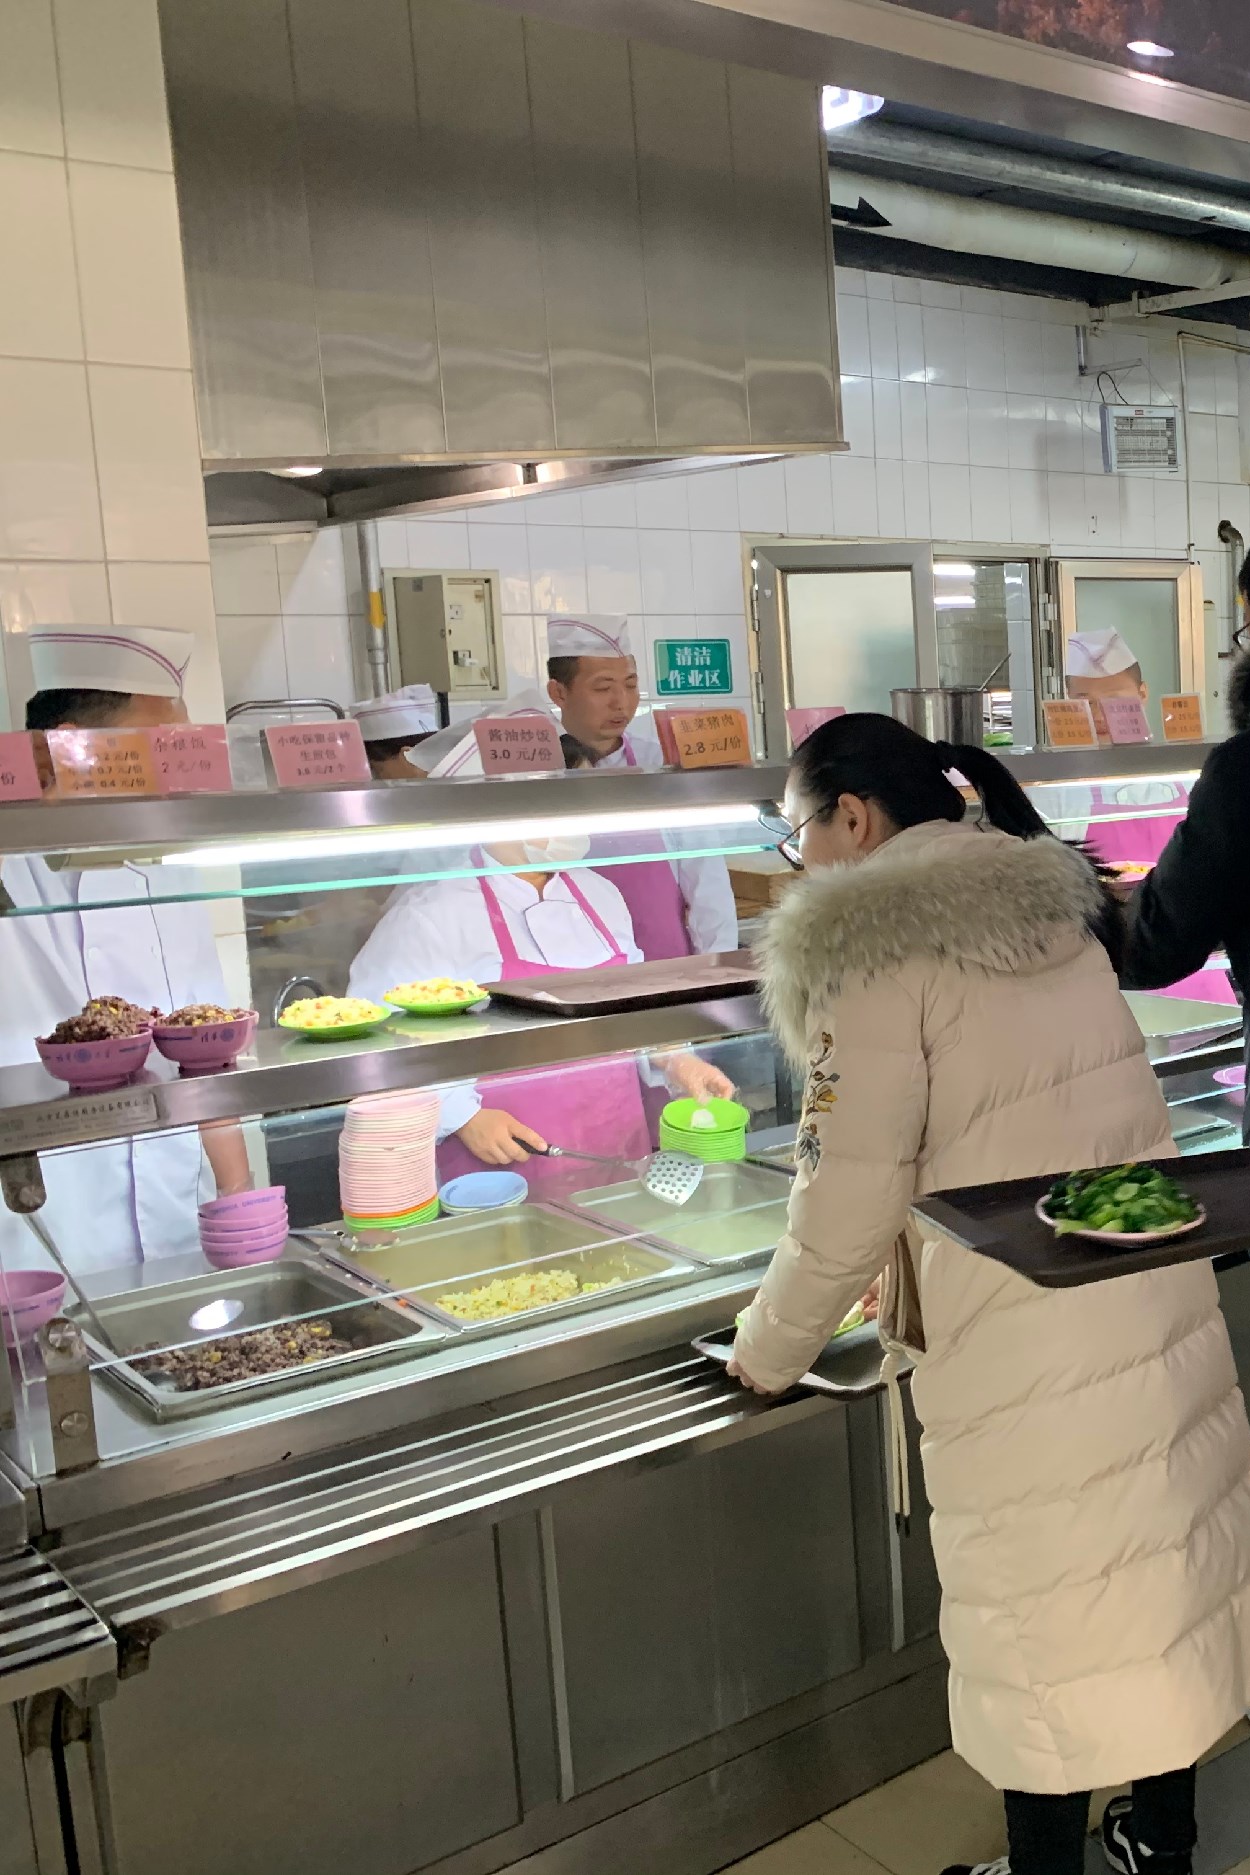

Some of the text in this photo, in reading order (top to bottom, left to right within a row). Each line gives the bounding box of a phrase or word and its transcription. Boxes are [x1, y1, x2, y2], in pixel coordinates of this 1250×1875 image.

[675, 646, 712, 666] 清洁
[668, 668, 722, 689] 作业区
[488, 728, 551, 742] 酱油炒饭
[489, 747, 552, 761] 3.0 元/份
[683, 735, 742, 756] 2.8 元/份
